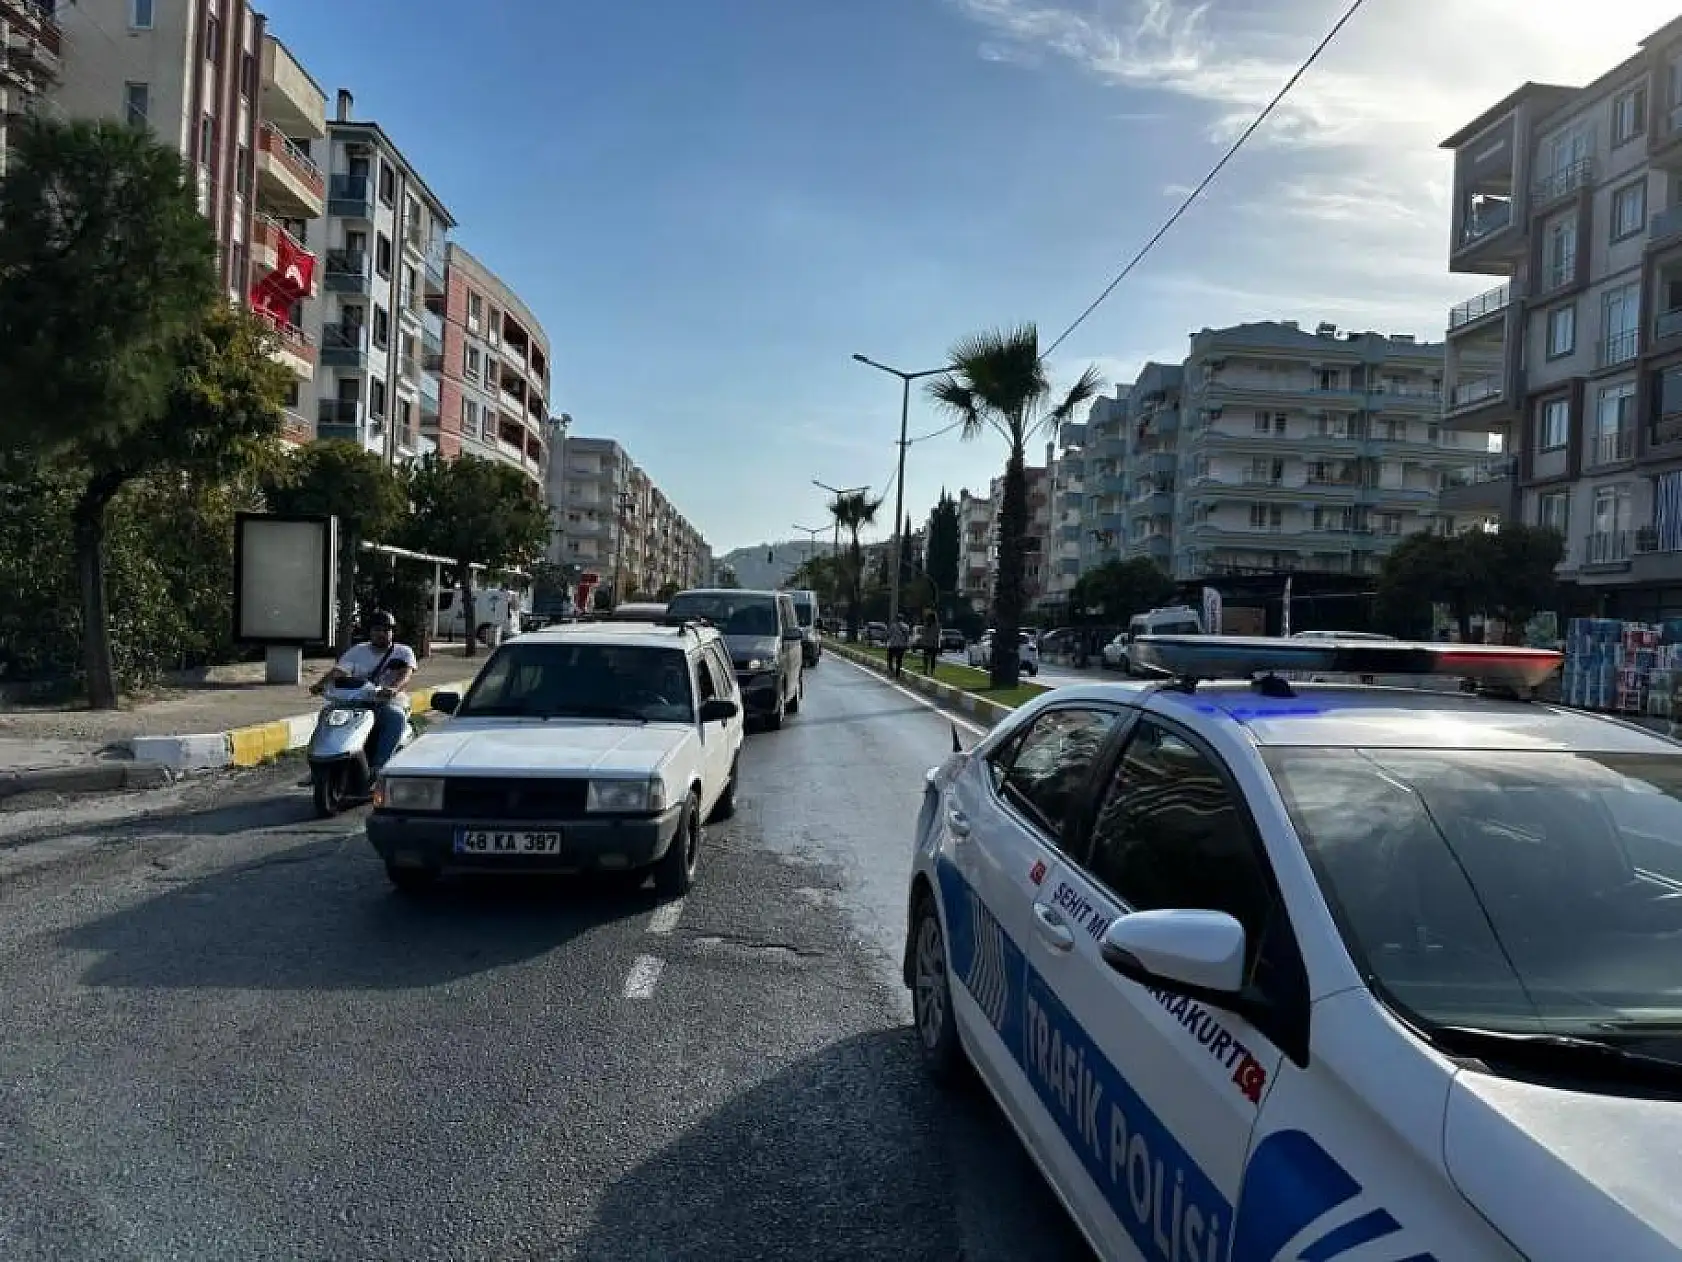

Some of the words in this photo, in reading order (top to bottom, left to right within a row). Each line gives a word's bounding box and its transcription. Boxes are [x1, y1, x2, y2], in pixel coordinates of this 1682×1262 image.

[465, 833, 487, 851] 48
[494, 833, 517, 851] KA
[1027, 993, 1103, 1160] TRAFİK
